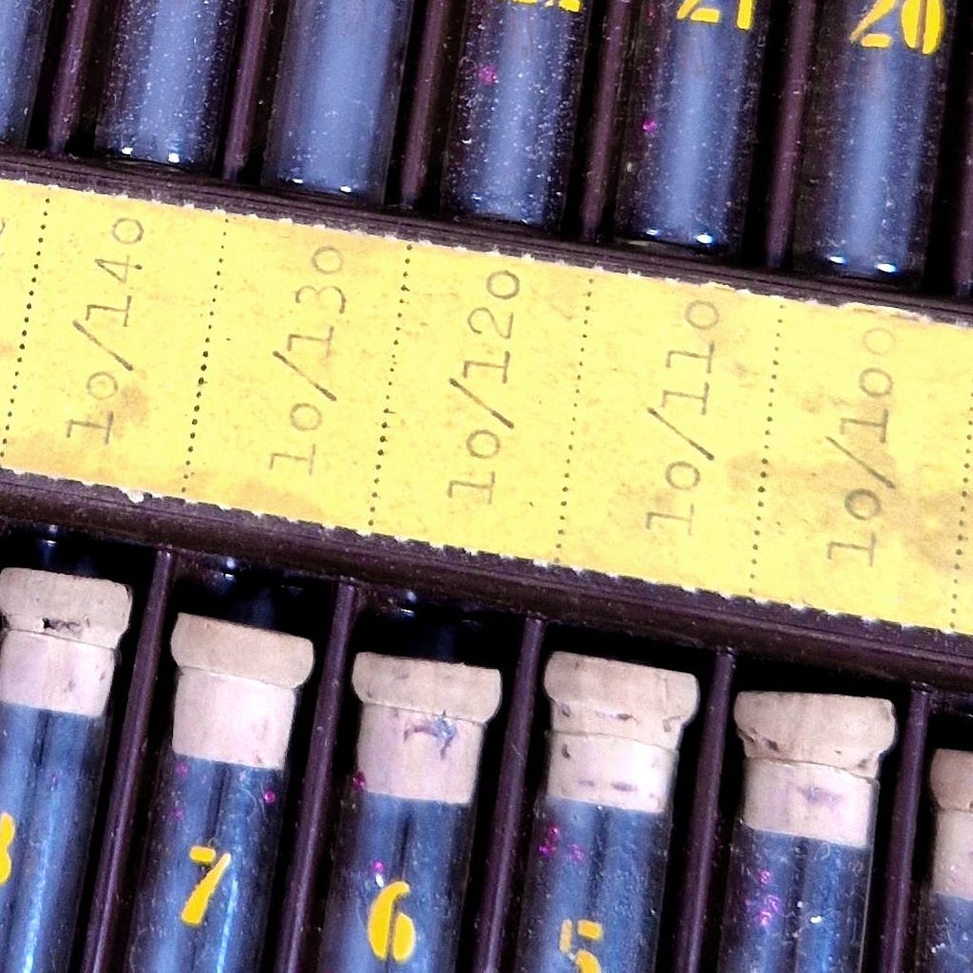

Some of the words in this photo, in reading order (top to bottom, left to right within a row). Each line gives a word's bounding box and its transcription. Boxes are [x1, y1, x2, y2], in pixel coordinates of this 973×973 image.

[66, 218, 144, 444] 10/140
[270, 245, 346, 476] 10/130
[447, 269, 521, 504] 10/120
[645, 299, 721, 536] 10/110
[826, 327, 895, 567] 10/100
[180, 846, 230, 925] 7
[368, 880, 414, 962] 6
